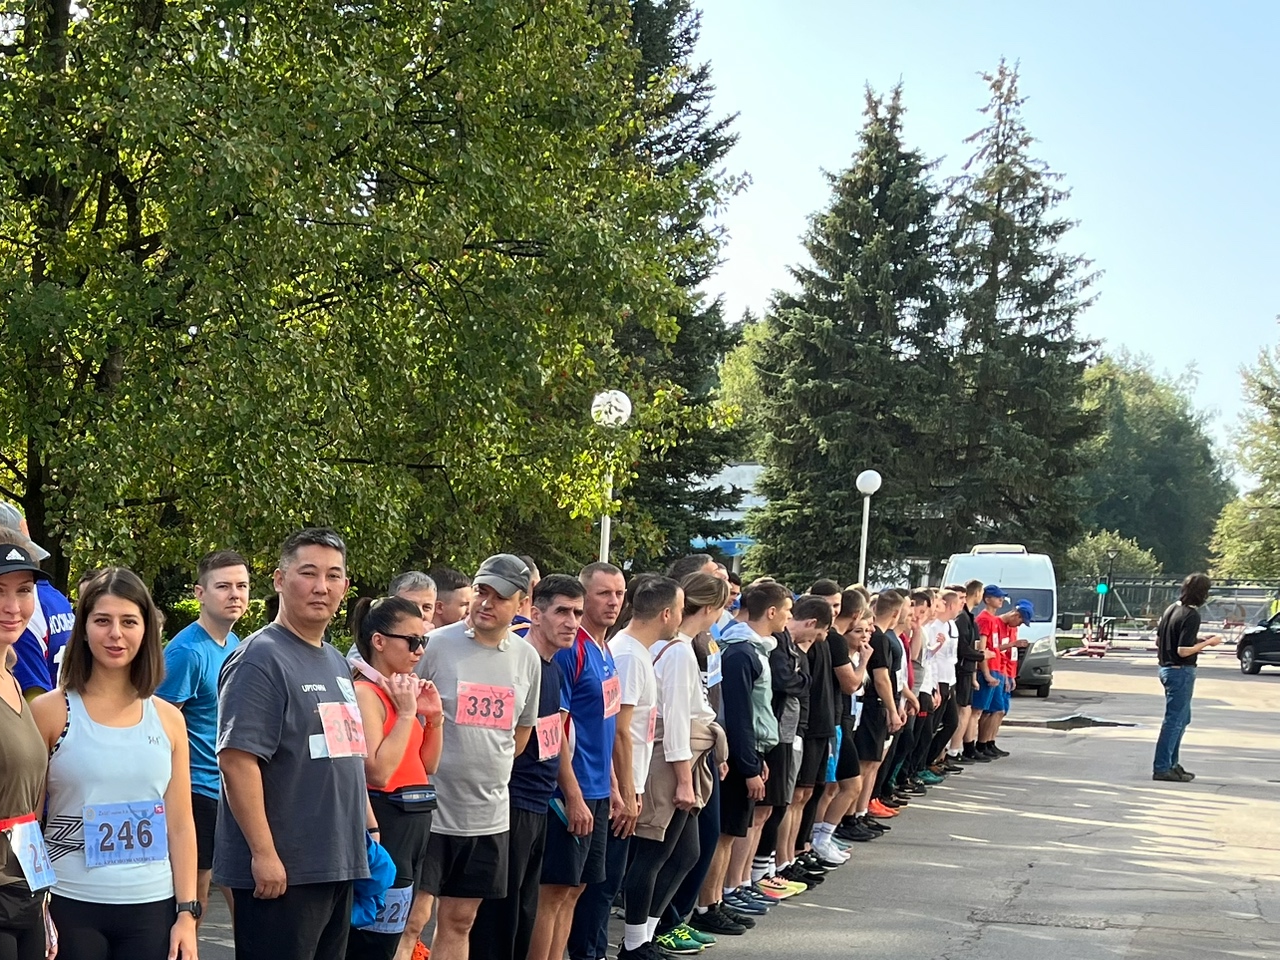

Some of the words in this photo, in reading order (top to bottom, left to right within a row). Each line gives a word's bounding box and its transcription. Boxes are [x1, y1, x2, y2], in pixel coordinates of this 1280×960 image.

[467, 696, 504, 718] 333
[543, 726, 559, 748] 310
[98, 819, 154, 853] 246
